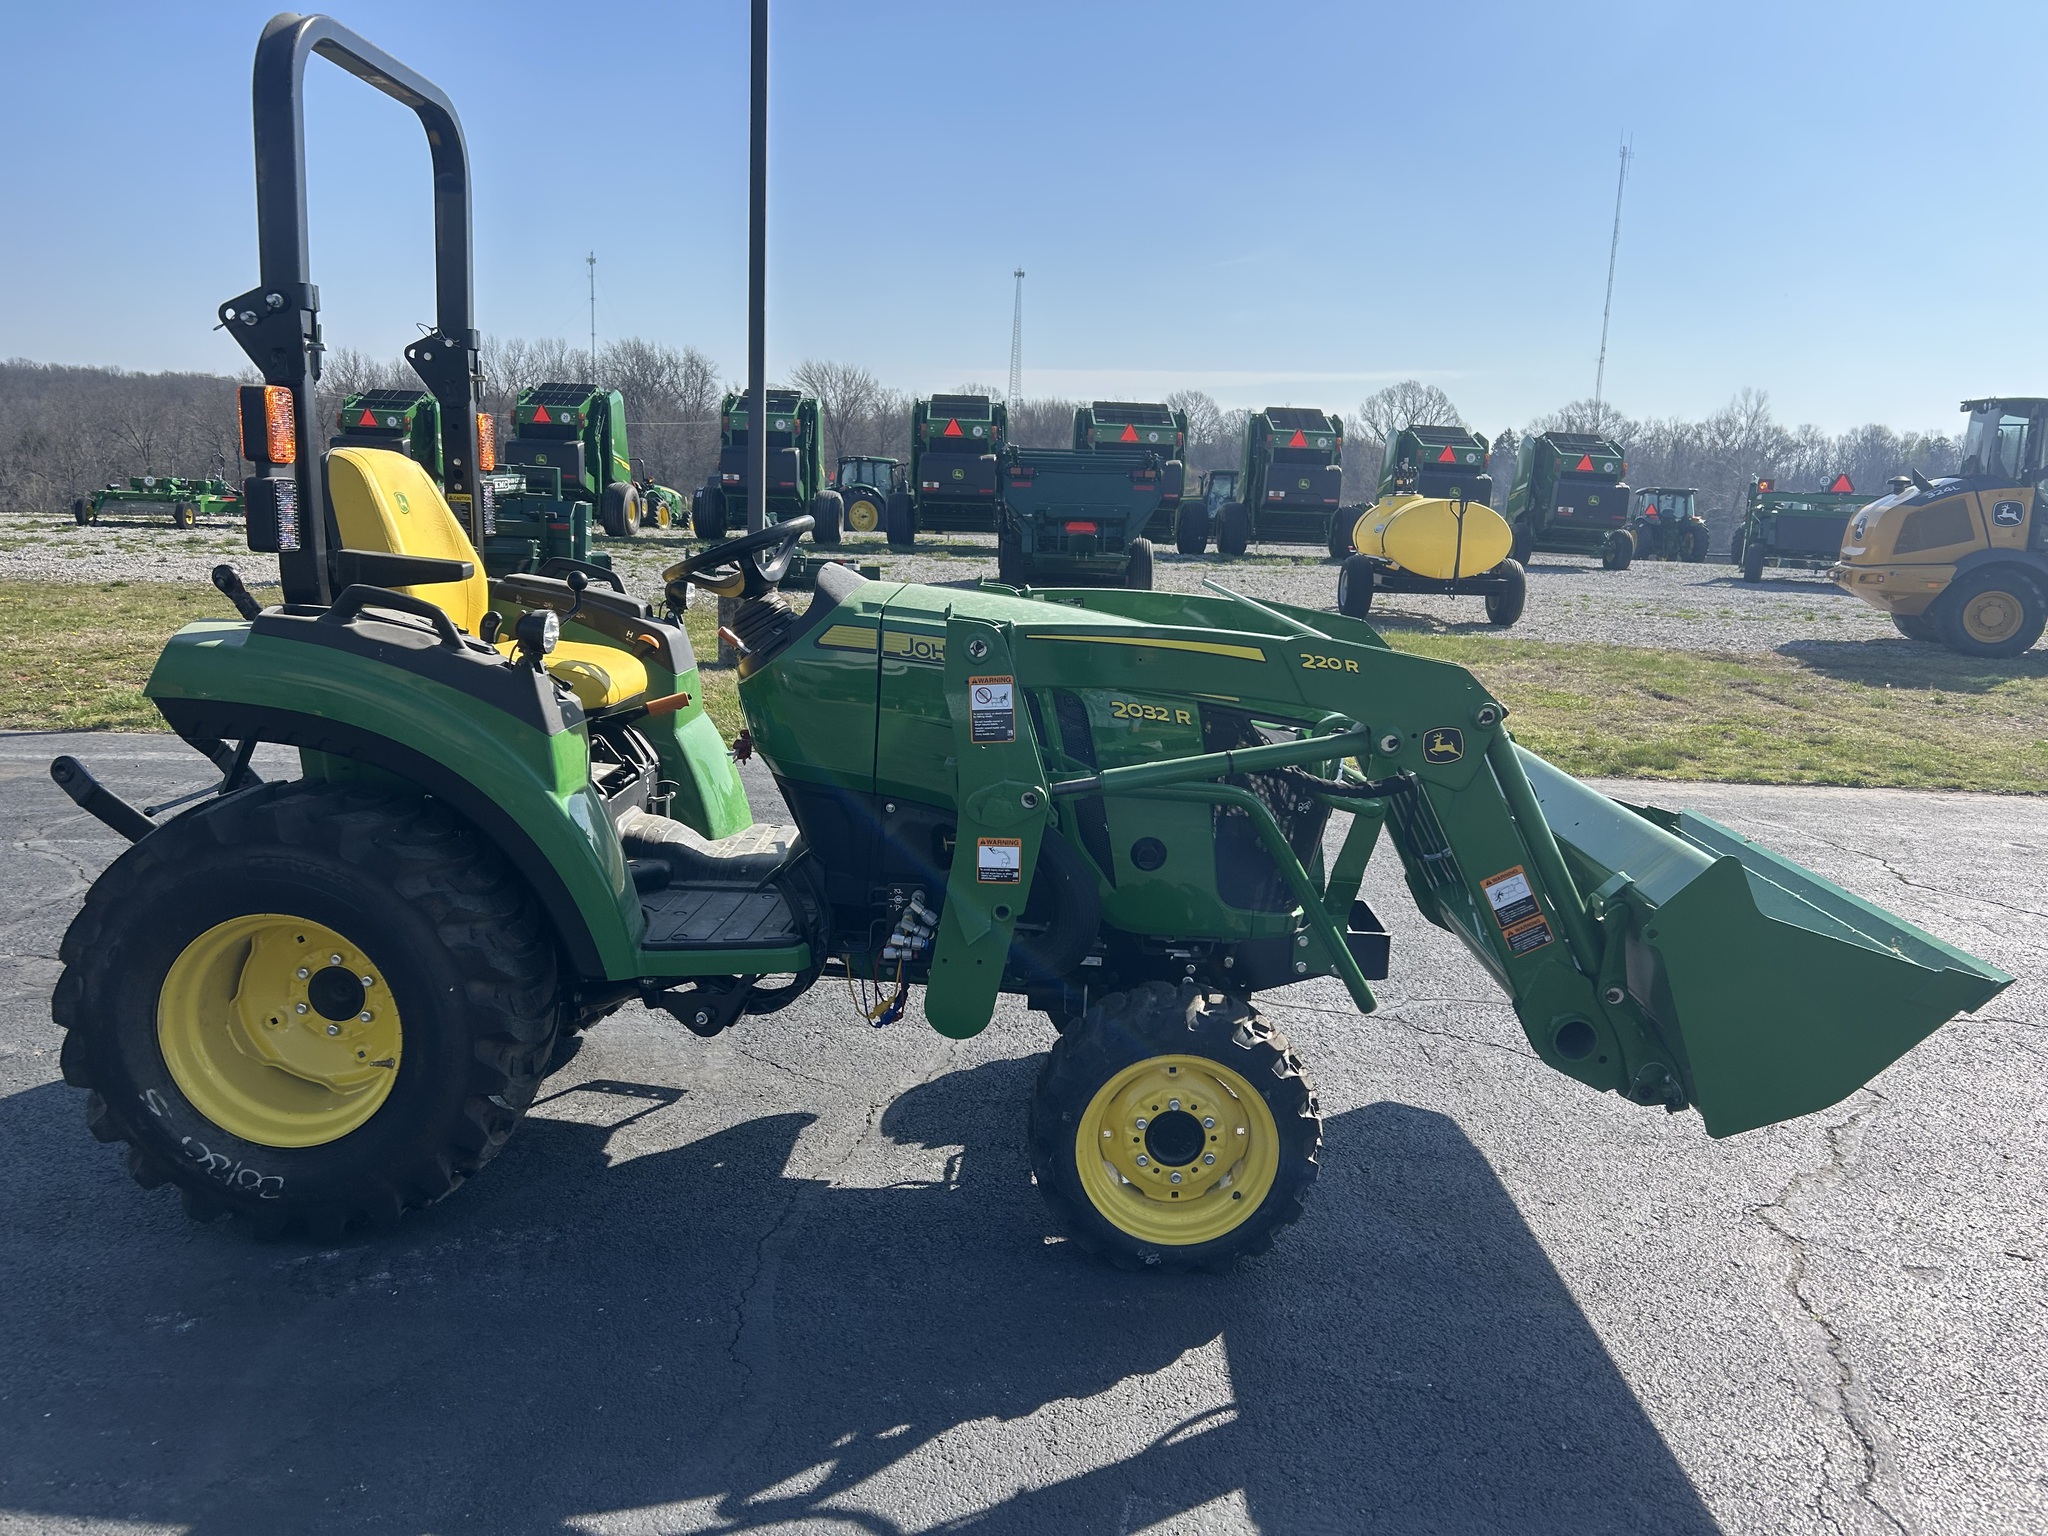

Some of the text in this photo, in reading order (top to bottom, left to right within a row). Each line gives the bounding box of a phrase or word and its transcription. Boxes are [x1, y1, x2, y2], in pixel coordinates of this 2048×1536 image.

[1300, 653, 1360, 674] 220 R
[1111, 701, 1192, 725] 2032 R
[1492, 868, 1518, 882] WARNING
[1514, 918, 1540, 932] WARNING
